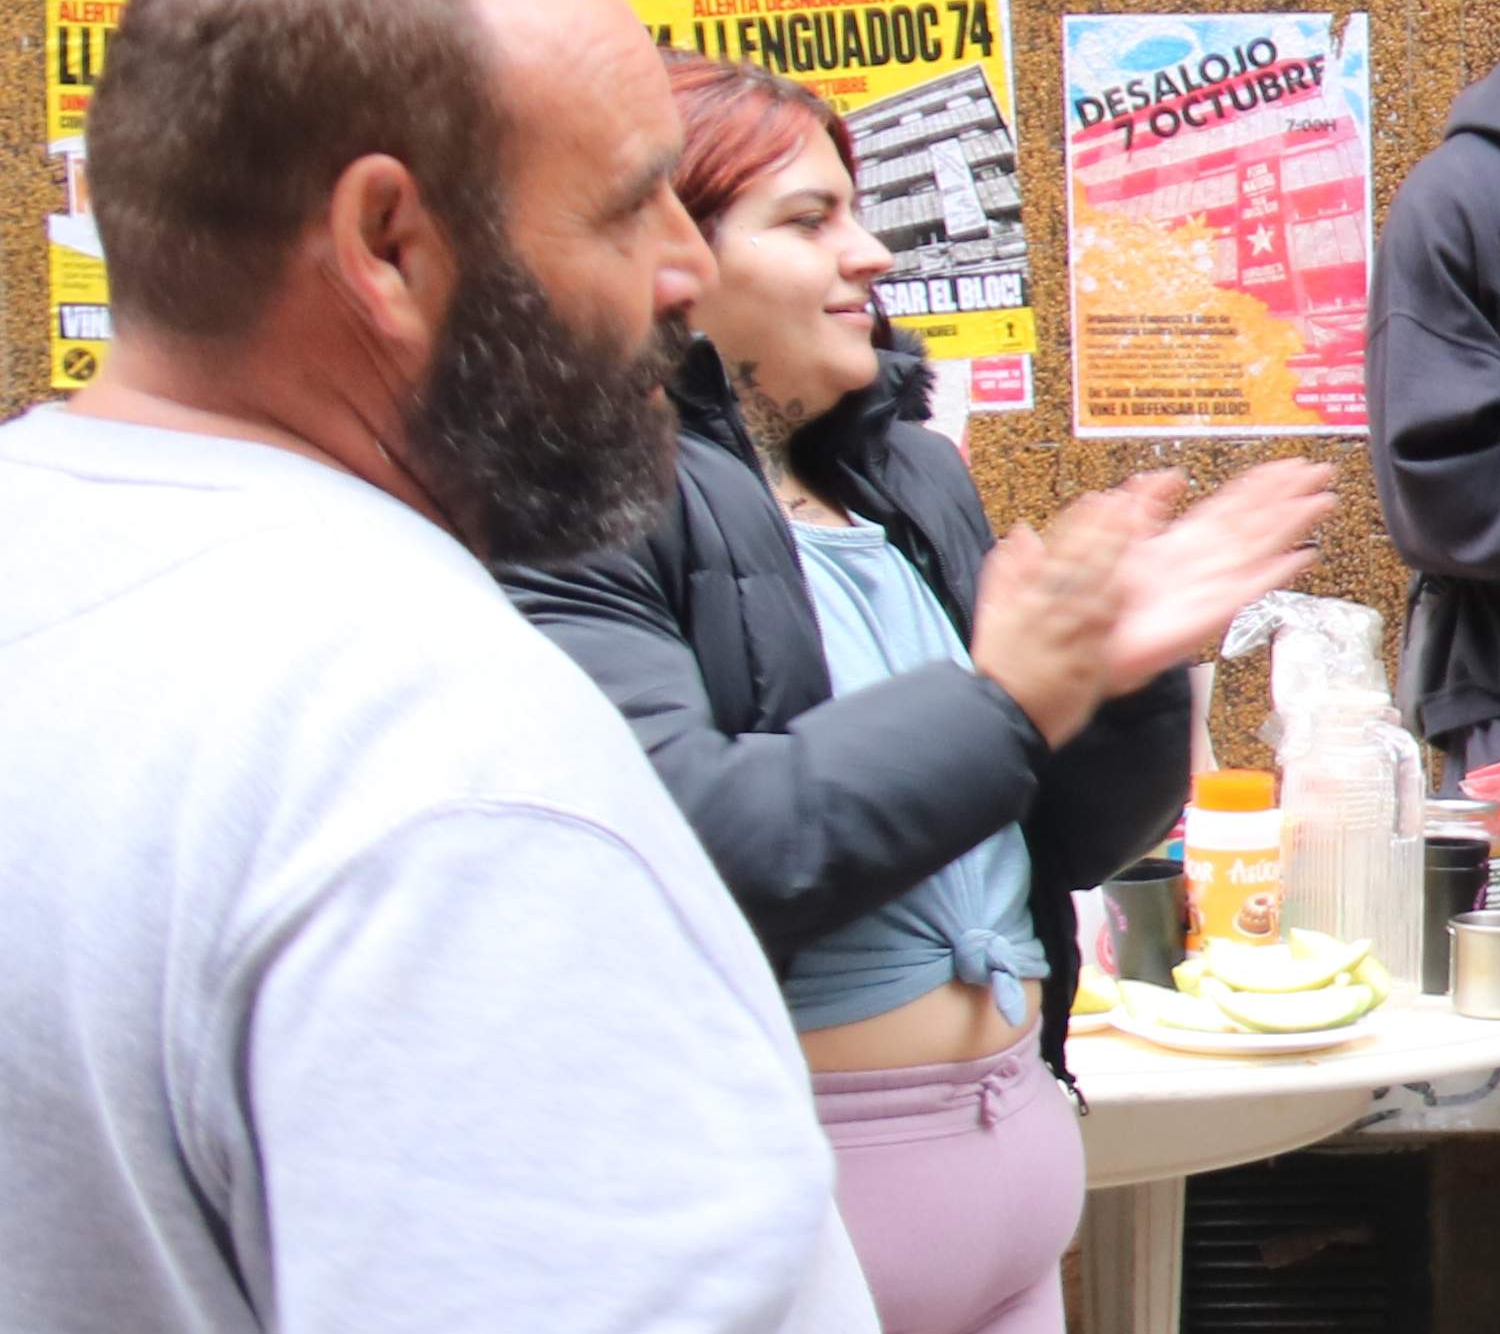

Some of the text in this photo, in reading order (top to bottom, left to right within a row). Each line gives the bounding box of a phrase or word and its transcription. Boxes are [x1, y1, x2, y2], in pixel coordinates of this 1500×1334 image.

[60, 0, 122, 23] ALERT
[1074, 37, 1277, 129] DESALOJO
[1113, 122, 1135, 151] 7
[928, 278, 957, 315] EL
[957, 272, 1023, 312] BLOC!
